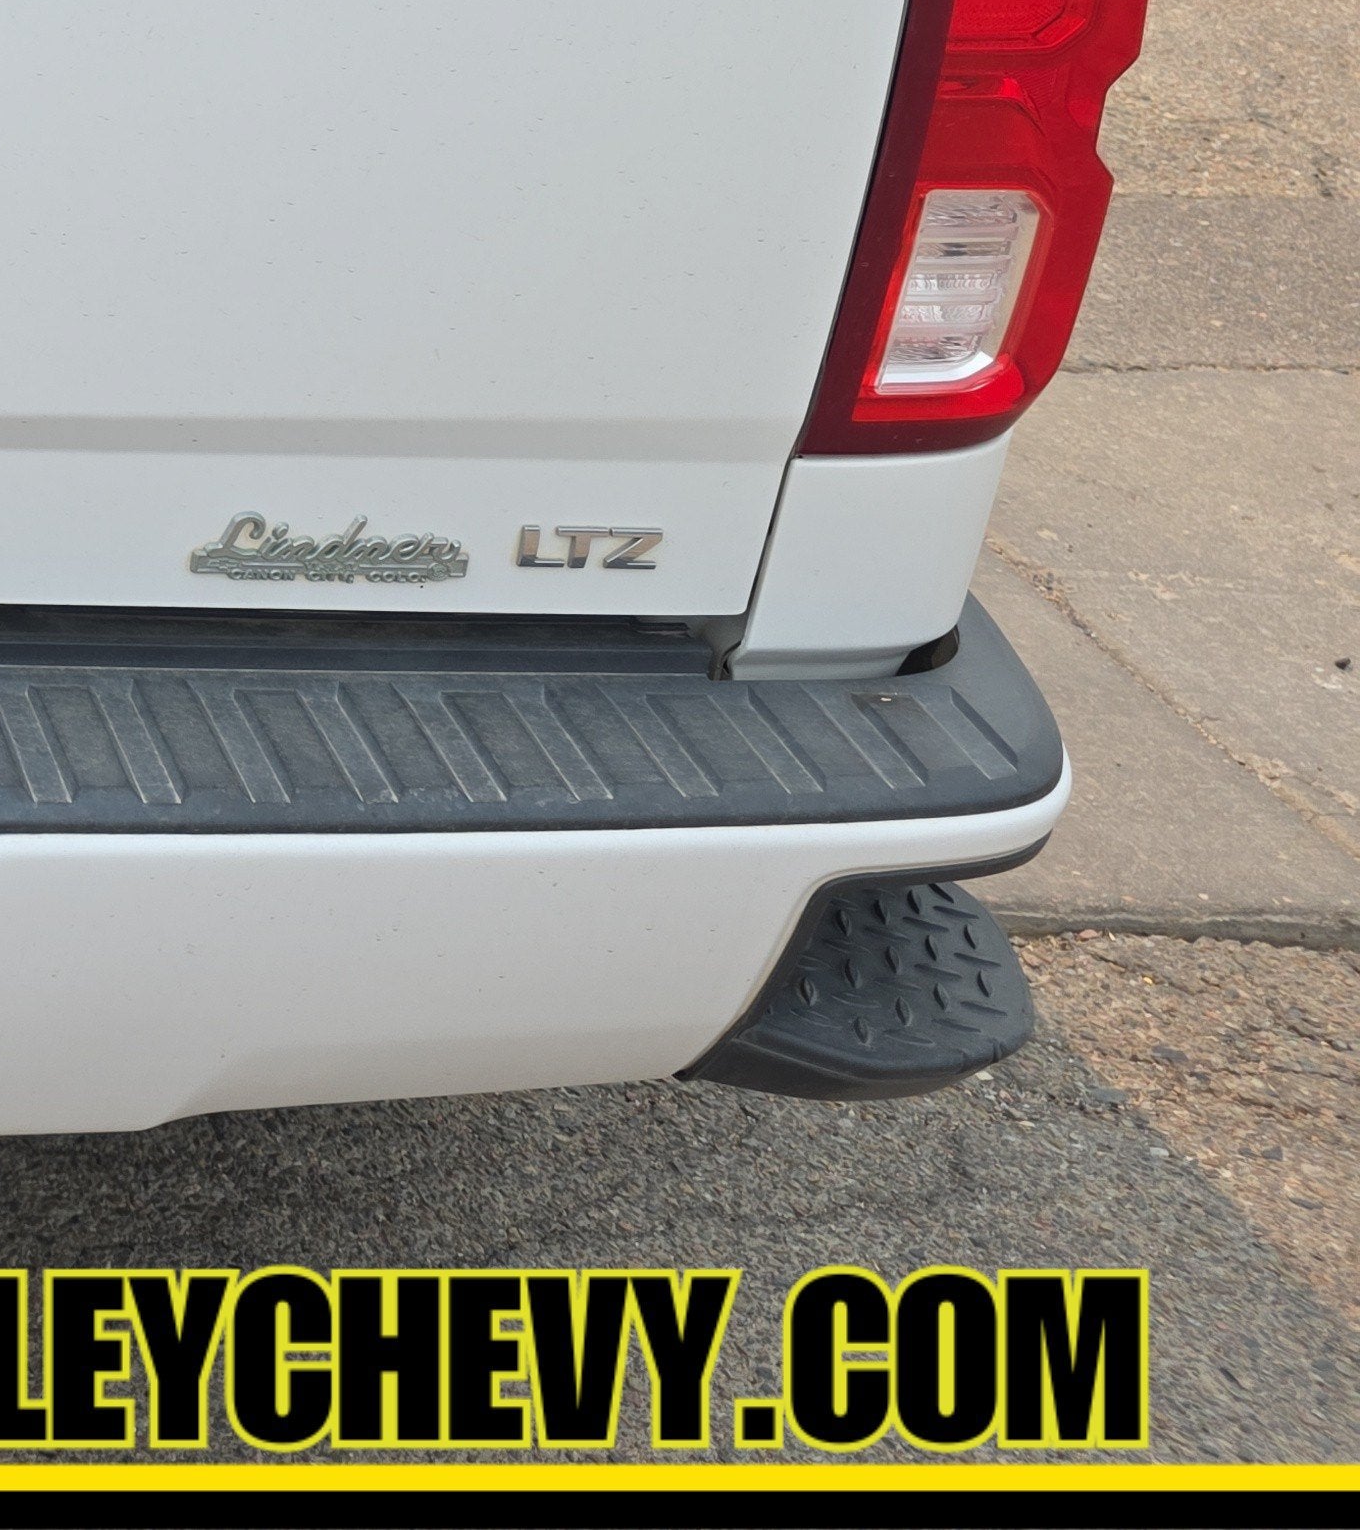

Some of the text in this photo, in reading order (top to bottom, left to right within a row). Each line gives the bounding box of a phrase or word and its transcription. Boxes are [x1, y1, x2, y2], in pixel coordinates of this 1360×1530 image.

[204, 510, 462, 563] Lindner
[516, 524, 664, 570] LTZ
[227, 568, 295, 583] CANON
